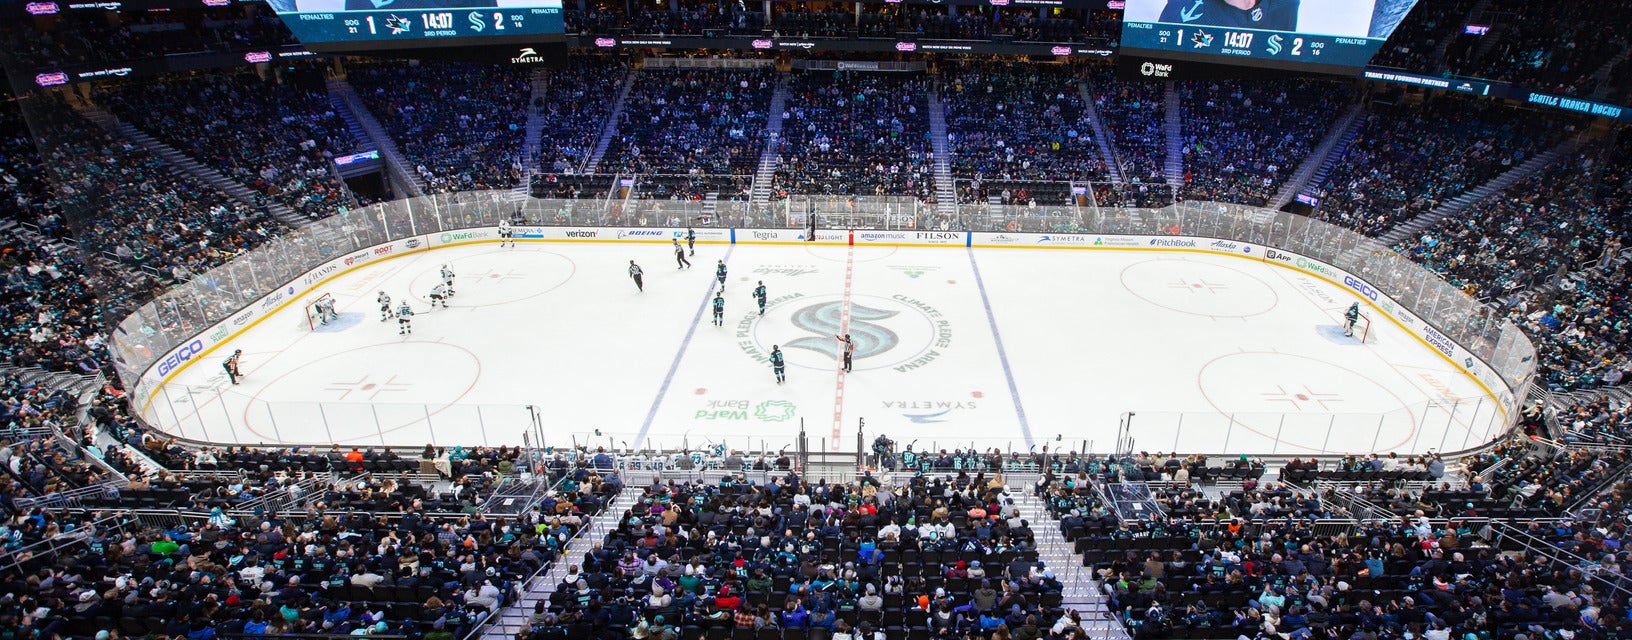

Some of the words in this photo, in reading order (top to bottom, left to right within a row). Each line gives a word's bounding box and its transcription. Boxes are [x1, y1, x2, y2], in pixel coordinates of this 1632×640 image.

[366, 15, 376, 34] 1
[421, 12, 453, 29] 14:07
[494, 12, 504, 30] 2
[1177, 29, 1184, 46] 1
[1223, 31, 1254, 48] 14:07
[1335, 37, 1367, 45] PENALTIES
[1291, 37, 1303, 55] 2
[1155, 63, 1172, 72] WaFd
[1365, 71, 1383, 79] THANK
[1421, 78, 1449, 88] PARTNERS
[1528, 93, 1559, 106] SEATTLE
[1559, 98, 1590, 113] KRAKEN
[1591, 103, 1622, 118] HOCKEY
[452, 232, 473, 240] WaFd
[472, 230, 488, 238] Bank
[566, 229, 596, 238] verizon
[752, 231, 778, 240] Tegria
[916, 232, 959, 240] FILSON
[374, 244, 393, 255] ROOT
[1157, 239, 1196, 248] PitchBook
[1210, 240, 1237, 250] Alaska
[312, 265, 337, 280] HANDS
[1307, 261, 1325, 273] WaFd
[1343, 275, 1378, 302] GEICO
[892, 294, 943, 319] CLIMATE
[233, 310, 254, 326] amazon
[935, 319, 953, 349] PLEDGE
[1423, 325, 1455, 351] AMERICAN
[1425, 334, 1453, 358] EXPRESS
[157, 339, 203, 377] GEICO
[892, 349, 941, 373] ARENA
[706, 399, 750, 410] Bank
[882, 400, 977, 410] SYMETRA
[694, 409, 748, 420] WaFd
